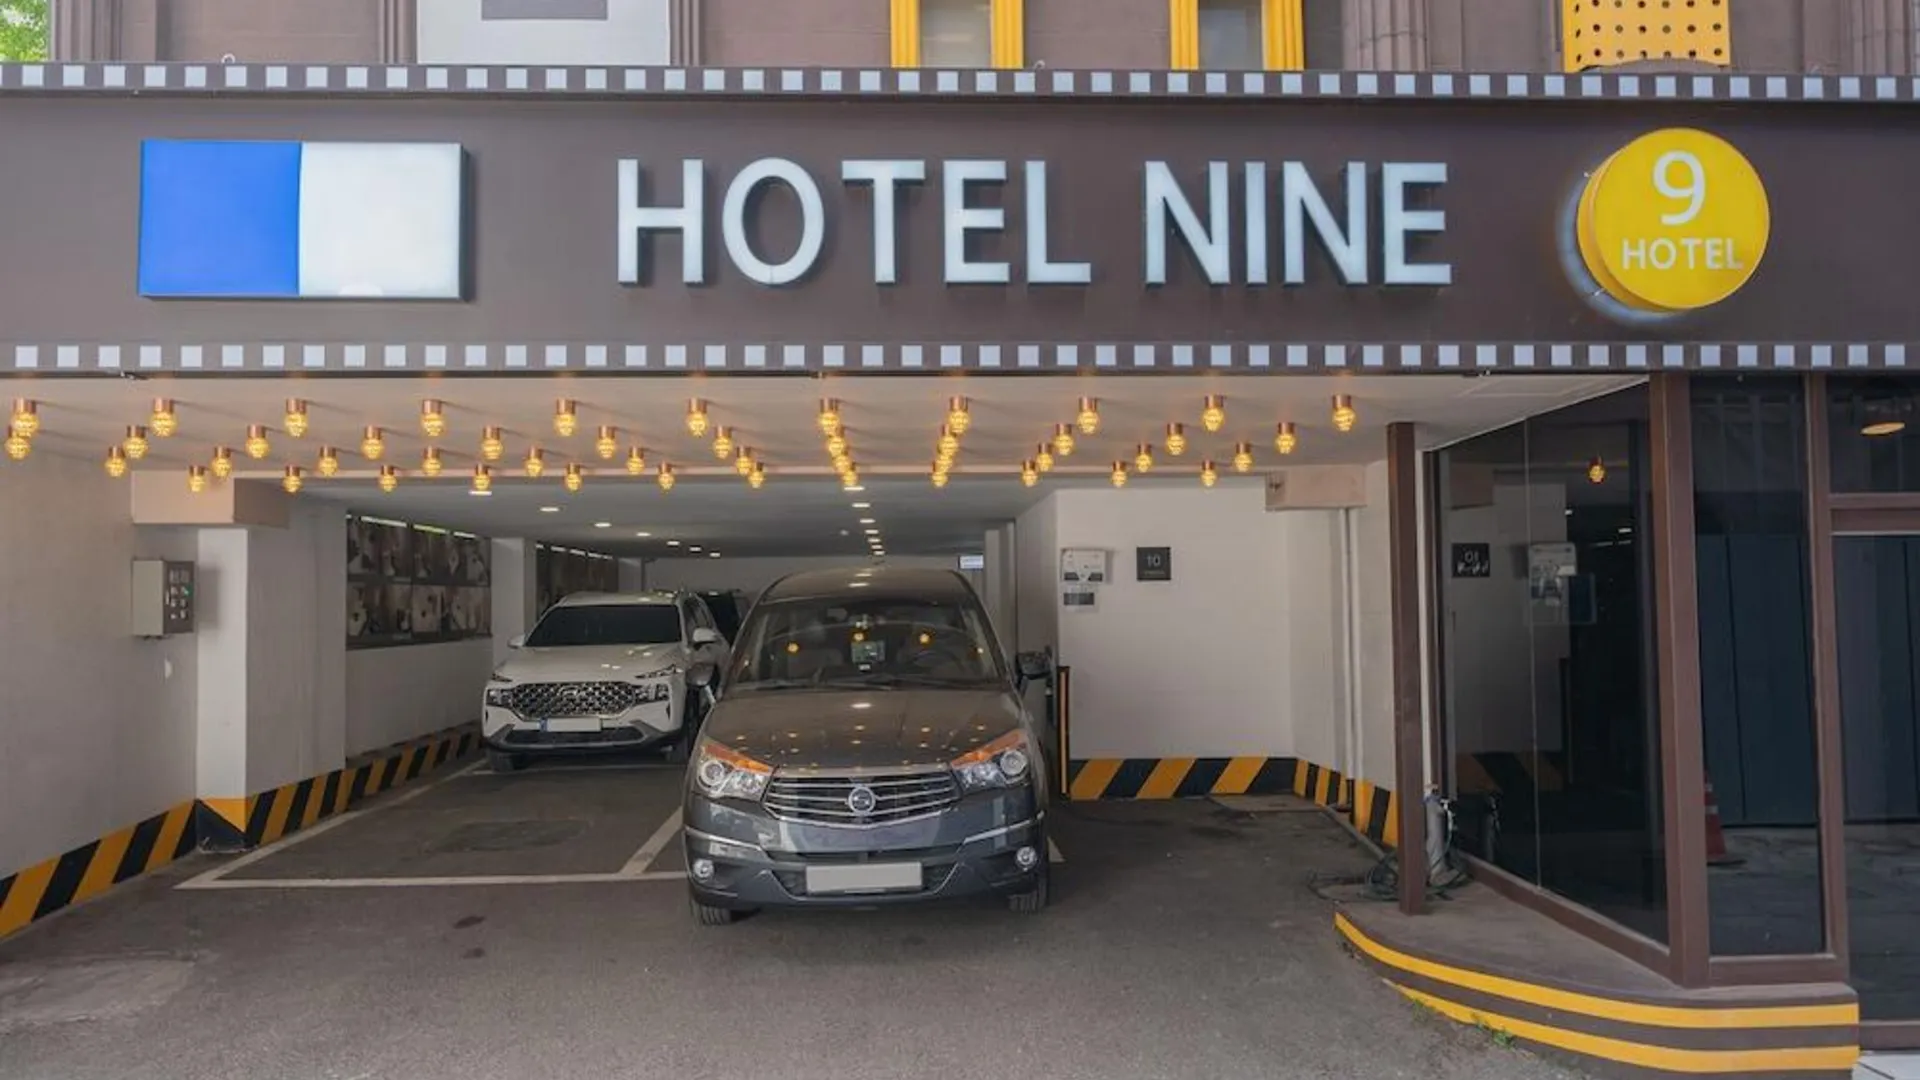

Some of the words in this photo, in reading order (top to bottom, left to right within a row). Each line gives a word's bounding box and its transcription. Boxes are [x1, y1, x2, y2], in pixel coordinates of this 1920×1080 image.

[617, 157, 1092, 285] HOTEL
[1144, 160, 1452, 286] NINE
[1652, 150, 1706, 226] 9
[1621, 237, 1744, 270] HOTEL
